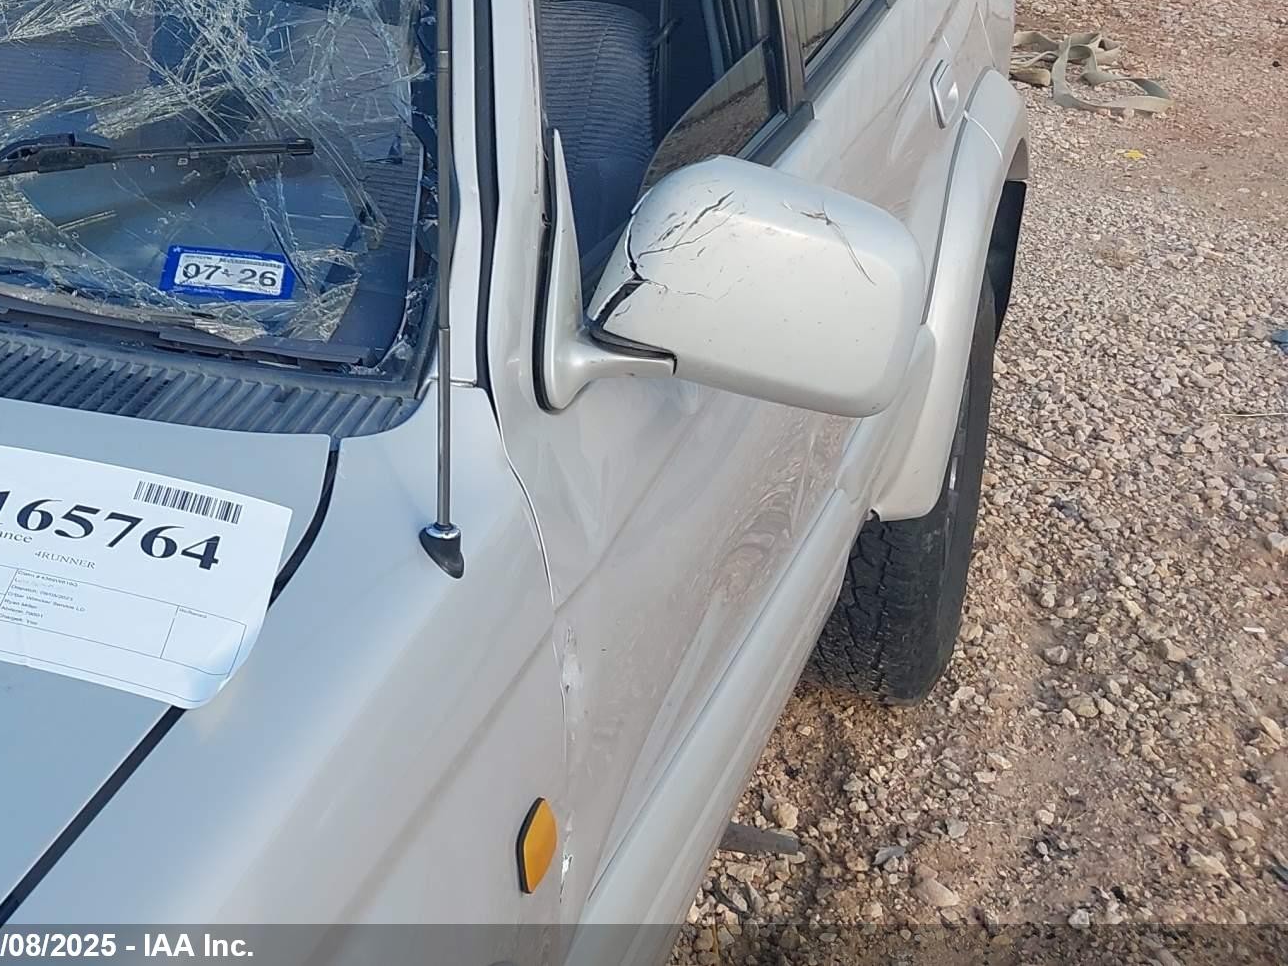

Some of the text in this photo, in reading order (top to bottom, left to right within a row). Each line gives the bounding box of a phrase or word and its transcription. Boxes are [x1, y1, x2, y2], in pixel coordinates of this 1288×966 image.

[182, 262, 222, 281] 07
[237, 267, 279, 287] 26
[33, 550, 96, 570] 4RUNNER
